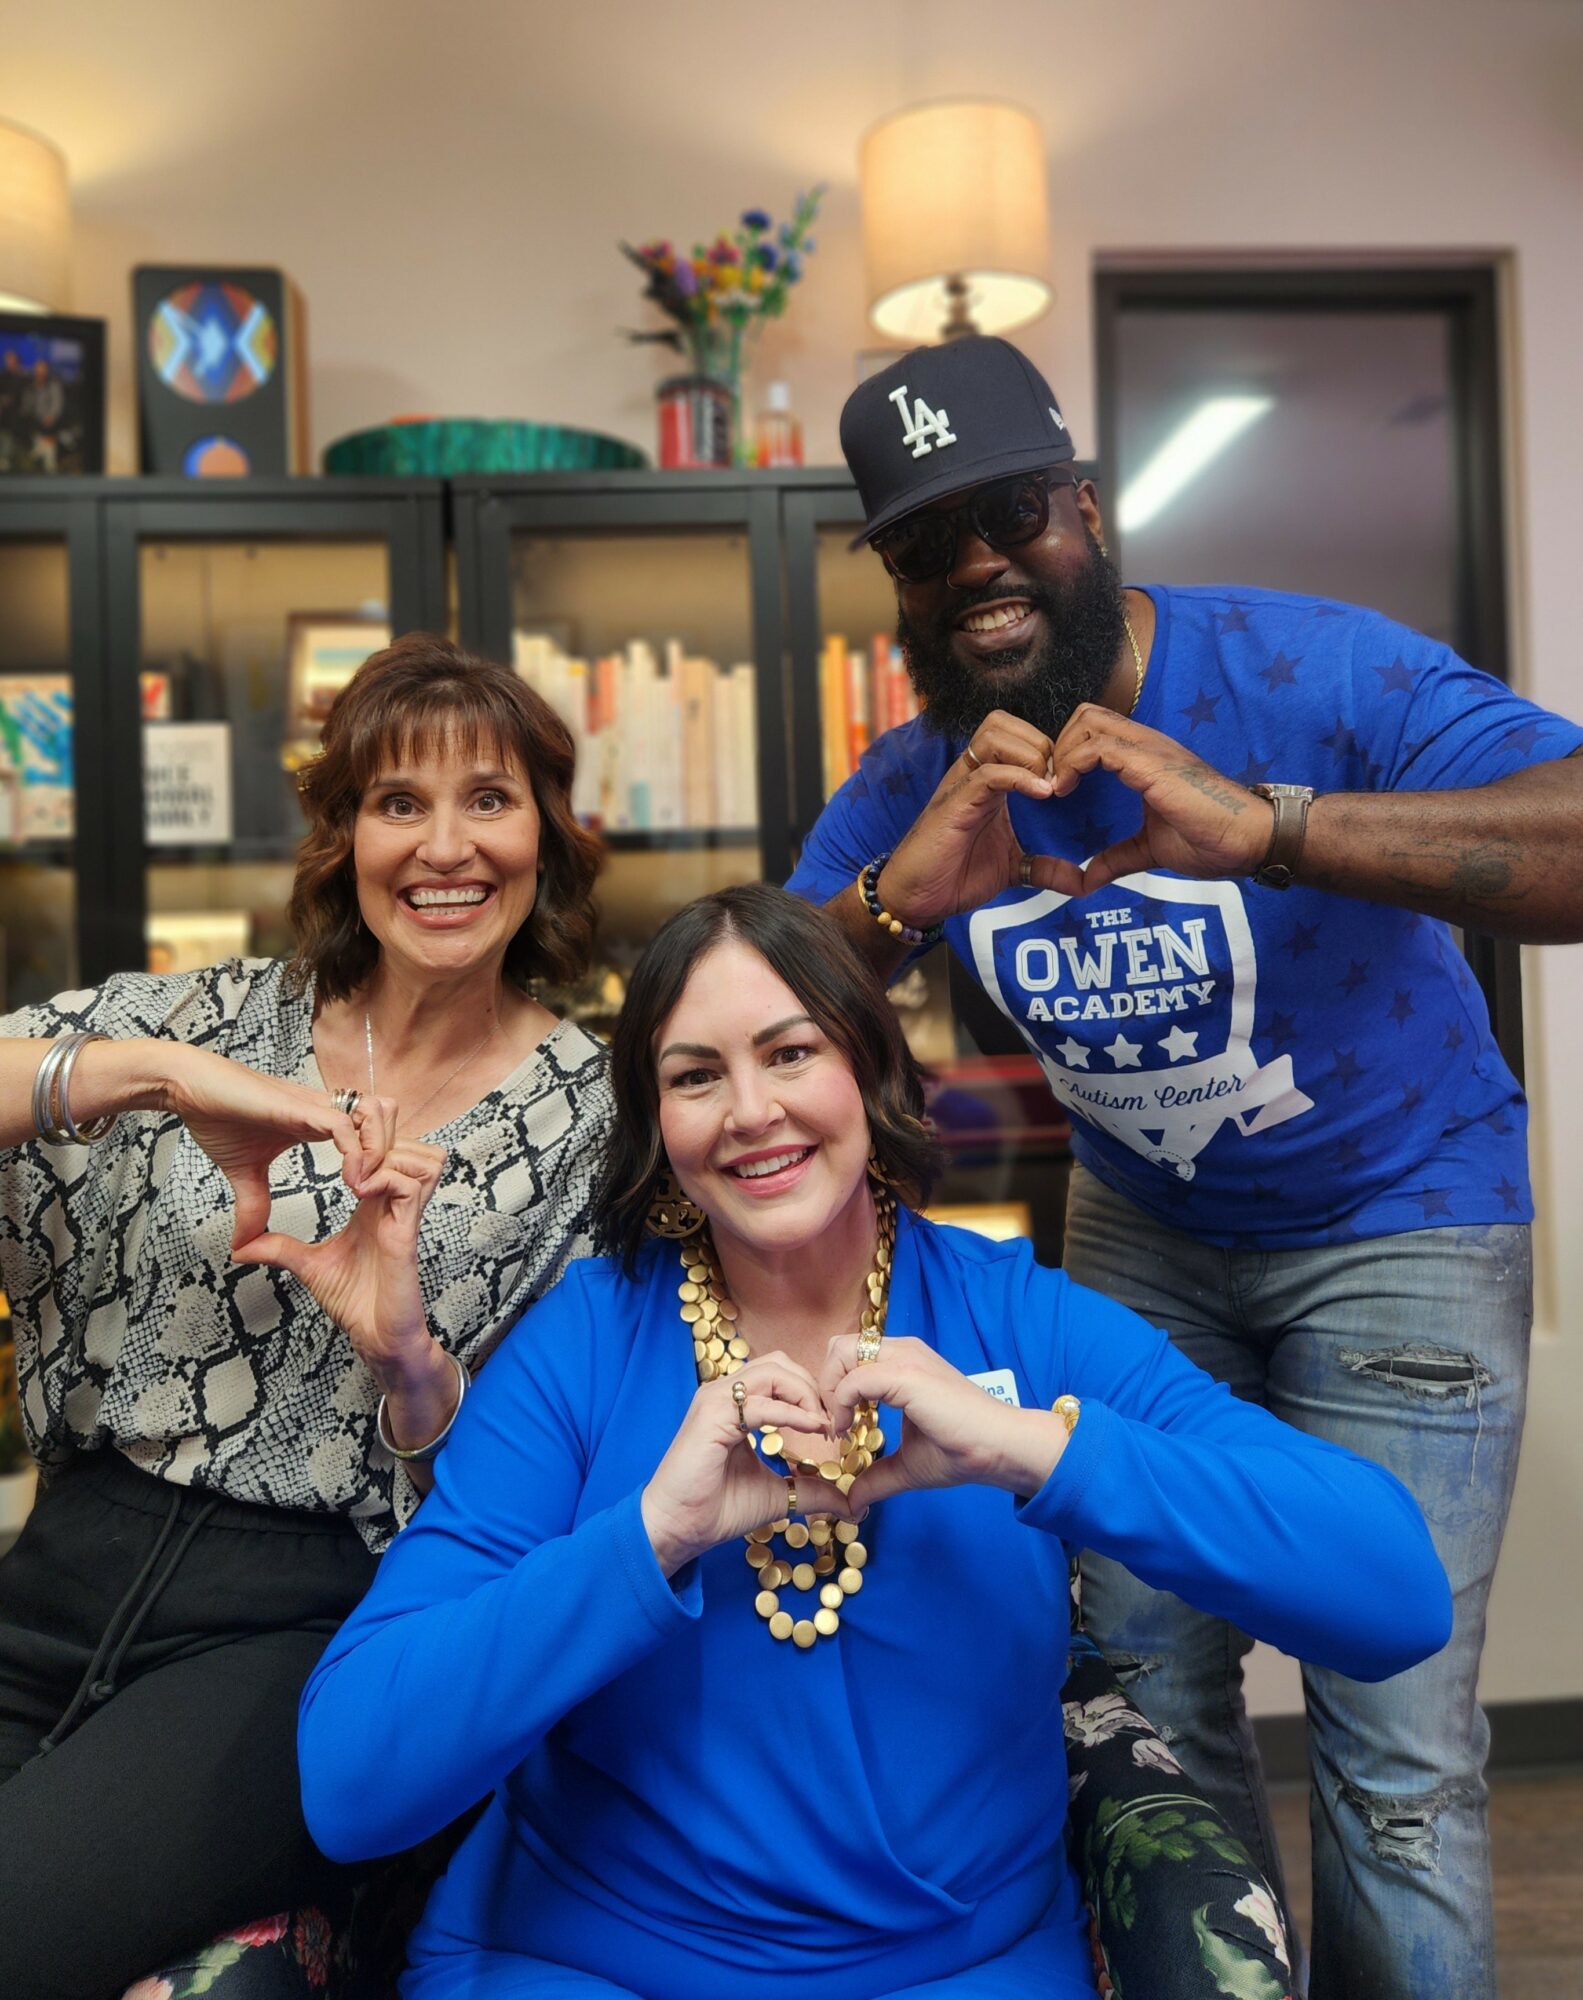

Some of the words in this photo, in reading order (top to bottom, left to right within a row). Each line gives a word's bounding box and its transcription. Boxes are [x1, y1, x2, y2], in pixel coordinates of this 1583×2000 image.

[888, 385, 957, 459] LA
[1085, 907, 1132, 929] THE
[1015, 917, 1211, 992] OWEN
[1026, 980, 1217, 1023] ACADEMY
[1059, 1078, 1148, 1111] Autism
[1154, 1073, 1247, 1108] Center
